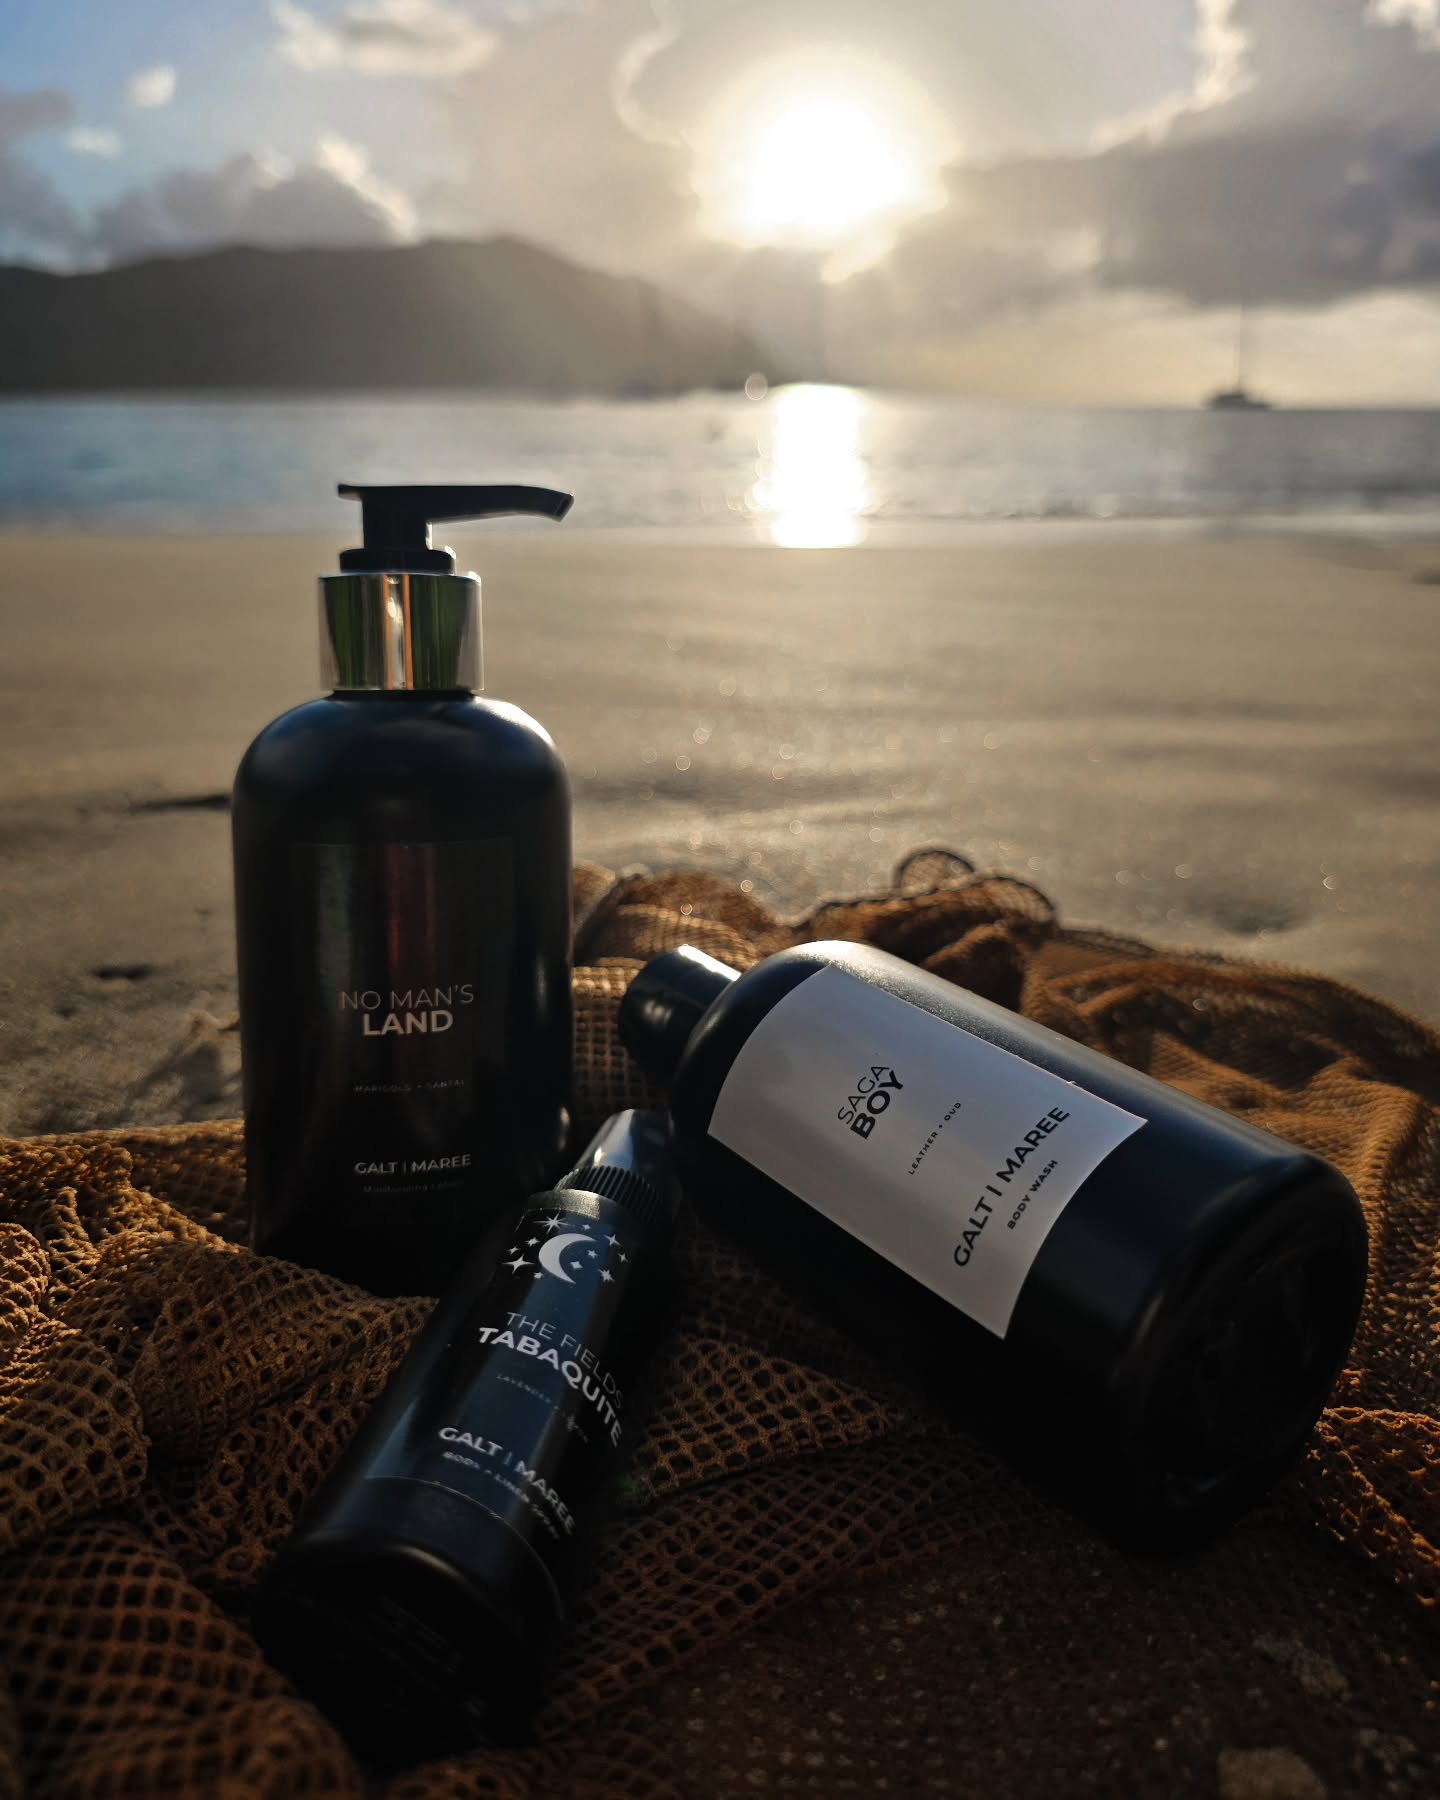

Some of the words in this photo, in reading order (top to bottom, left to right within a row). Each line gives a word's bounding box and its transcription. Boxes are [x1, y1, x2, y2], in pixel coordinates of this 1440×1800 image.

[341, 990, 381, 1010] NO
[390, 983, 475, 1009] MAN'S
[362, 1010, 454, 1036] LAND
[837, 1065, 891, 1125] SAGA
[849, 1069, 904, 1140] BOY
[353, 1160, 399, 1176] GALT
[411, 1153, 472, 1173] MAREE
[907, 1131, 939, 1176] LEATHER
[943, 1101, 962, 1122] OUD
[953, 1195, 994, 1267] GALT
[995, 1106, 1071, 1183] MAREE
[1007, 1196, 1032, 1231] BODY
[1029, 1159, 1059, 1193] WASH
[478, 1326, 623, 1448] TABAQUITE
[506, 1311, 557, 1338] THE
[559, 1333, 624, 1410] FIELDS
[438, 1427, 504, 1457] GALT
[514, 1460, 577, 1536] MAREE
